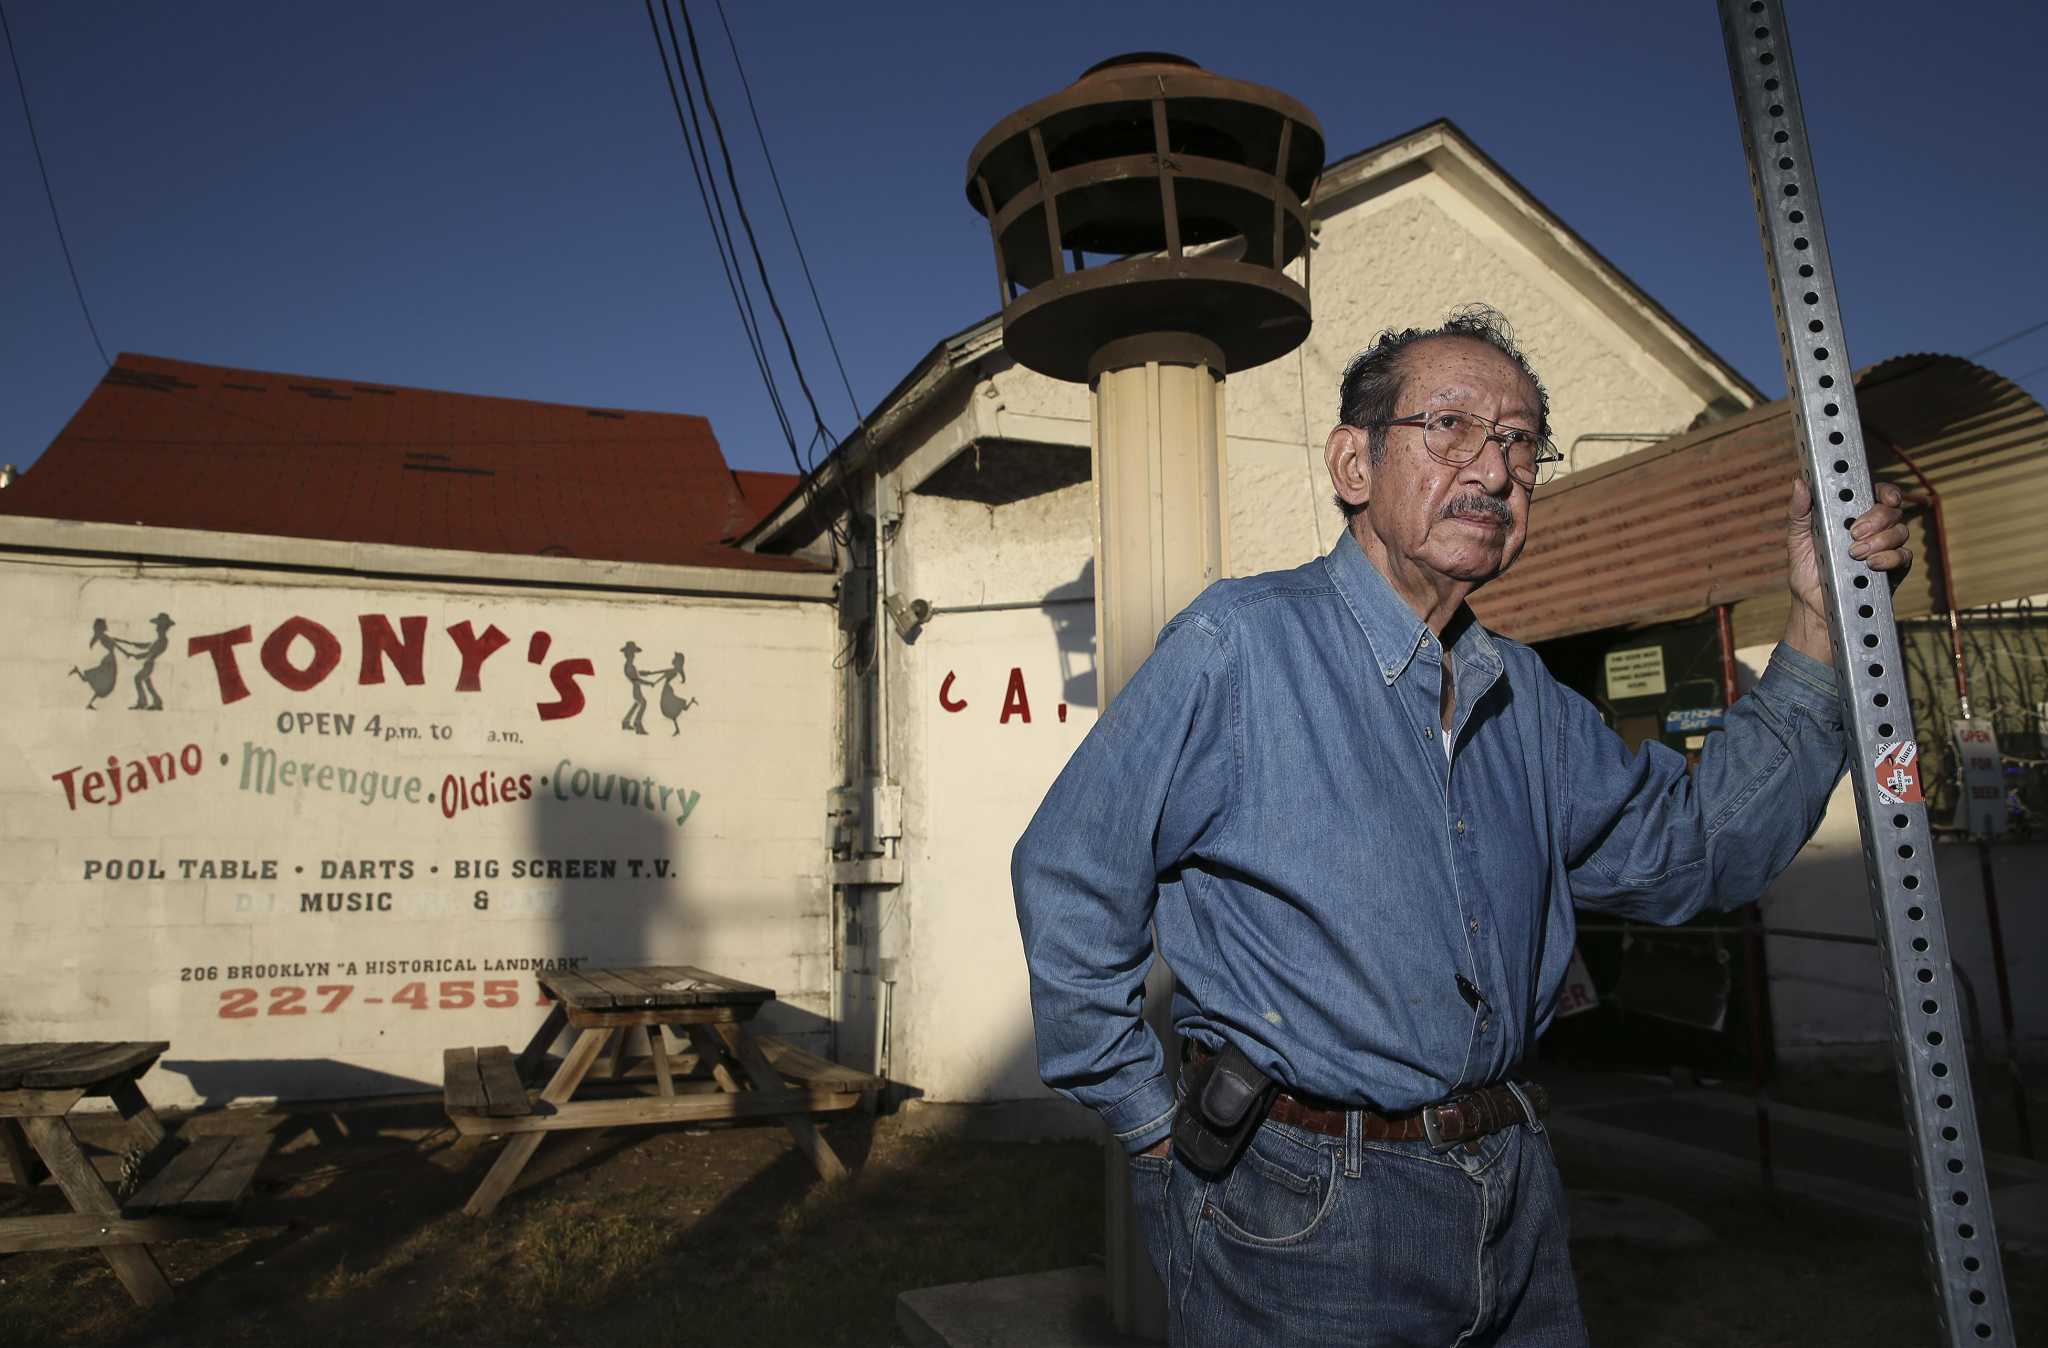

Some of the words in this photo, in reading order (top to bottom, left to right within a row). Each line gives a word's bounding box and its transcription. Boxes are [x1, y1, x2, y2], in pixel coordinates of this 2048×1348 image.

[188, 614, 595, 721] TONY'S
[276, 711, 355, 735] OPEN
[430, 722, 453, 741] to
[52, 744, 202, 811] Tejano
[239, 741, 422, 806] Merengue
[441, 770, 533, 819] Oldies
[553, 759, 701, 827] Country
[83, 859, 165, 880] POOL
[179, 859, 278, 880] TABLE
[320, 860, 414, 880] DARTS
[454, 860, 499, 879] BIG
[512, 859, 616, 879] SCREEN
[628, 860, 677, 878] T.V.
[300, 892, 392, 912] MUSIC
[474, 890, 488, 910] &
[180, 966, 218, 982] 206
[227, 963, 329, 979] BROOKLYN
[366, 957, 476, 975] HISTORICAL
